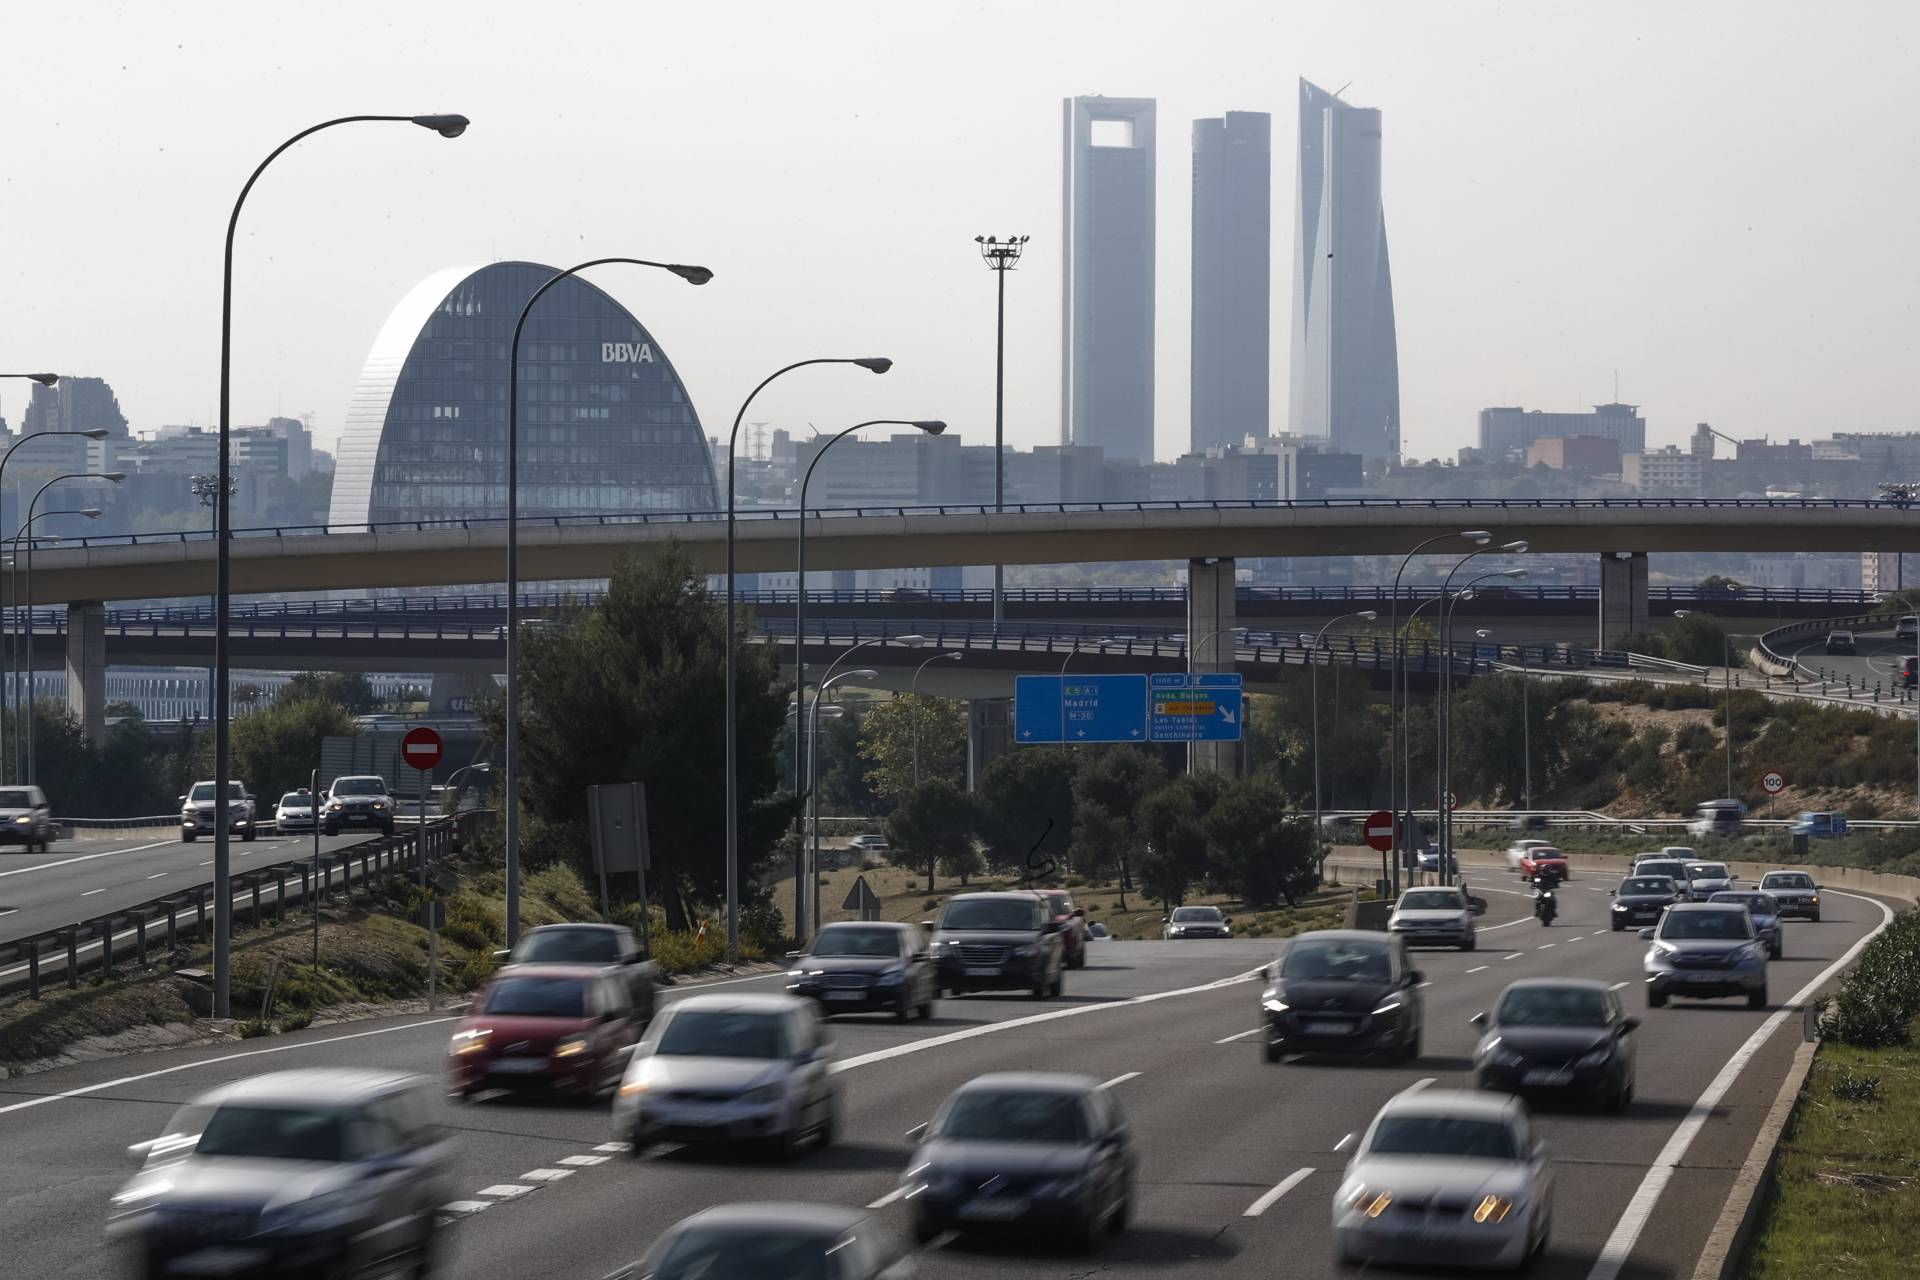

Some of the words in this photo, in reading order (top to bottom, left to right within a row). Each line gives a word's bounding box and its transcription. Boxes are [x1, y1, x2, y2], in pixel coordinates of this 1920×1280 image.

[602, 343, 654, 363] BBVA
[1064, 699, 1098, 707] Madrid
[1765, 778, 1782, 787] 100
